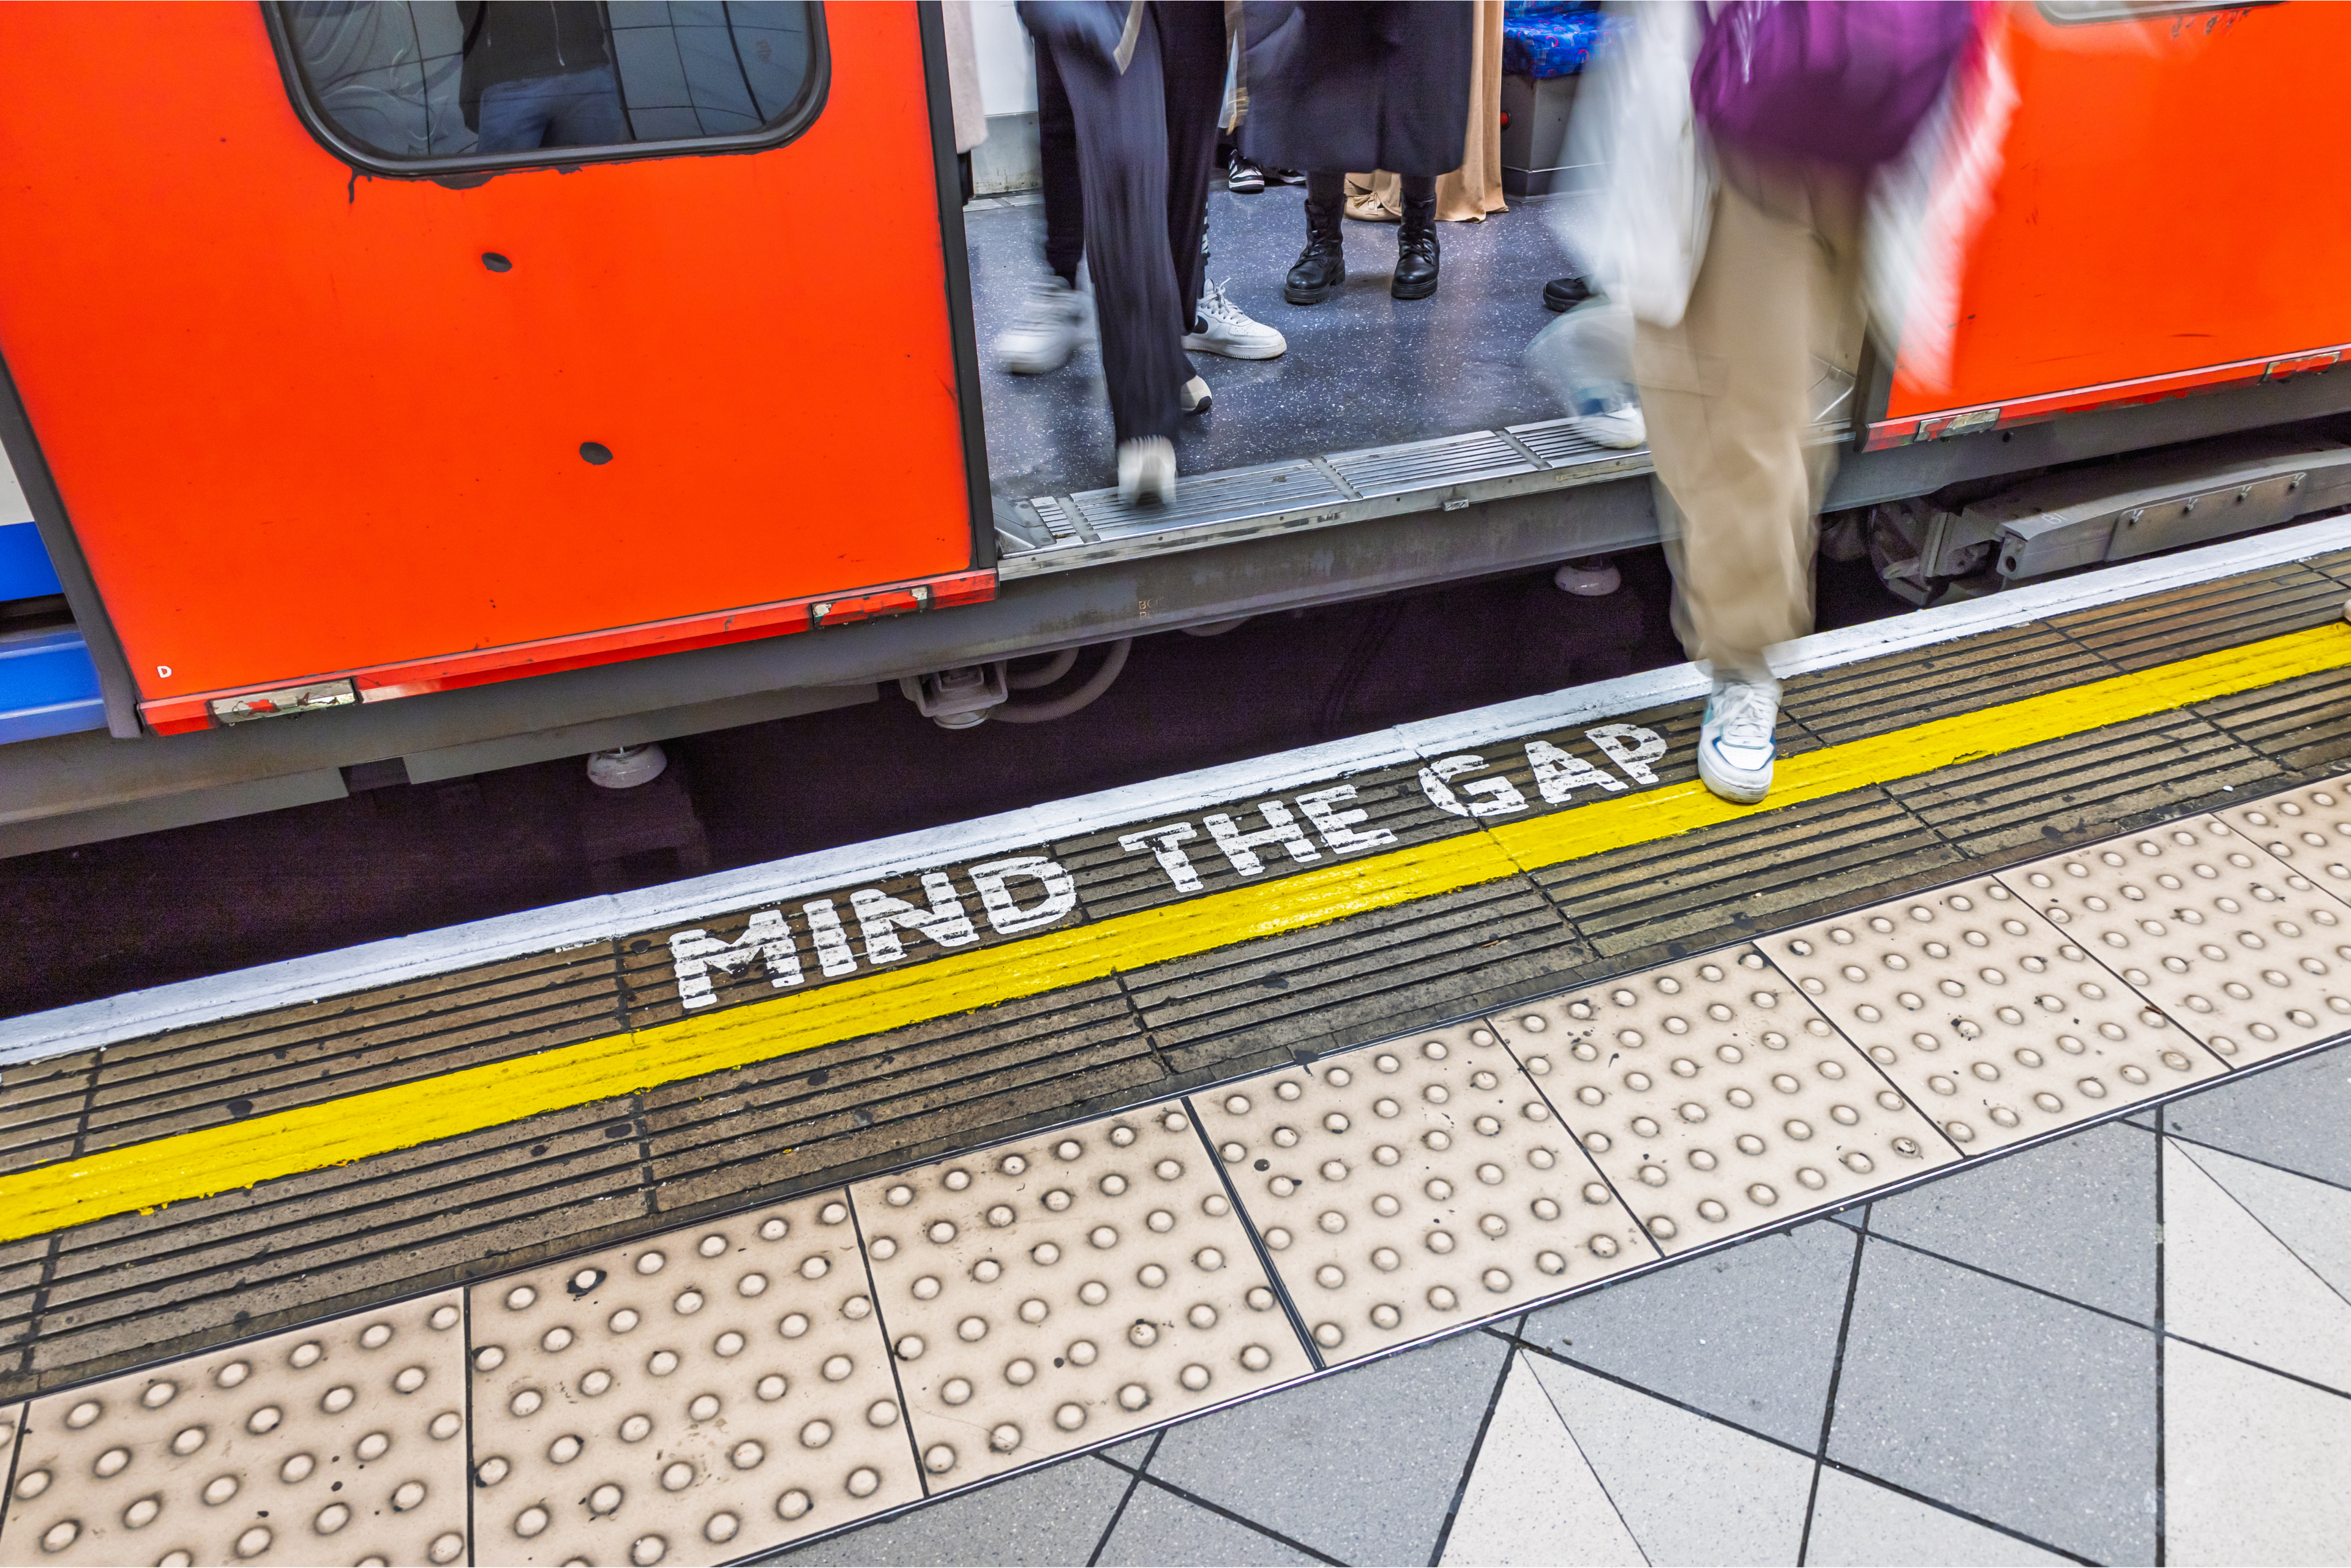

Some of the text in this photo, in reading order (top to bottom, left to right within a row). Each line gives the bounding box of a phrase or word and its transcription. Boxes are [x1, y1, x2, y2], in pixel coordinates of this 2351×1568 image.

[157, 665, 172, 678] D
[669, 723, 1669, 1009] MIND THE GAP
